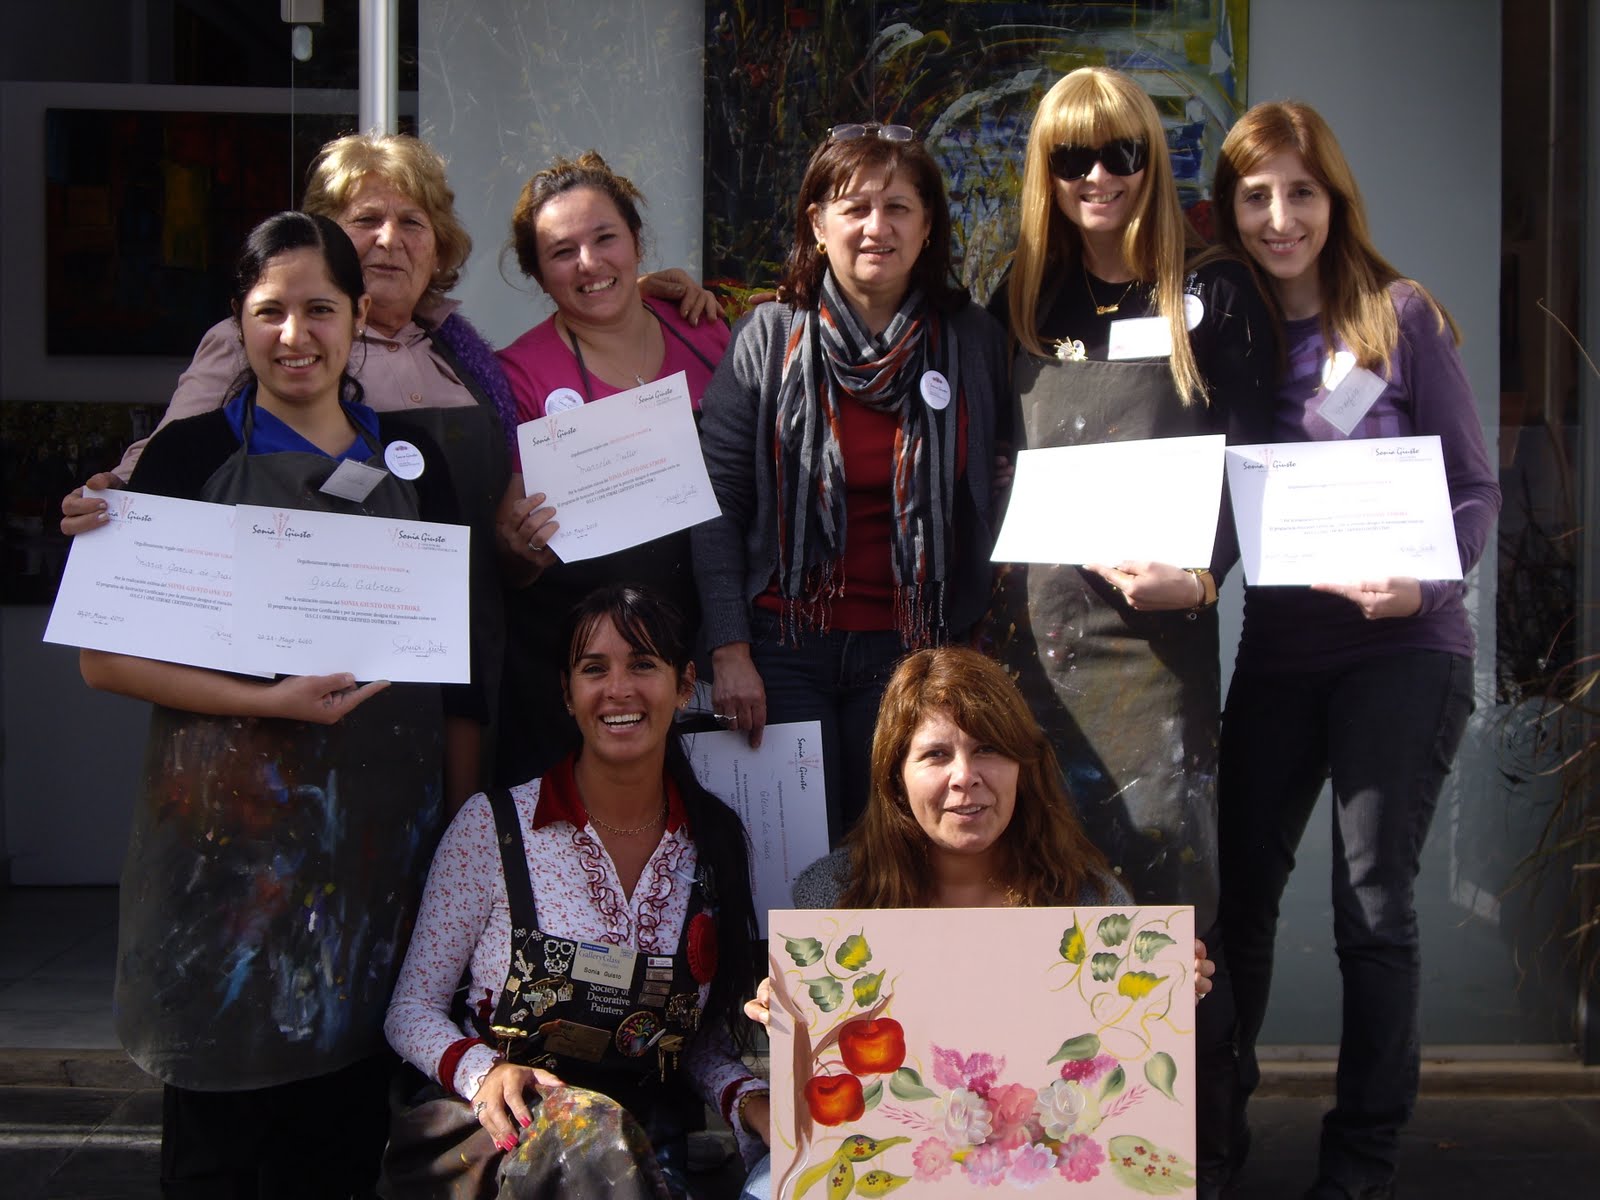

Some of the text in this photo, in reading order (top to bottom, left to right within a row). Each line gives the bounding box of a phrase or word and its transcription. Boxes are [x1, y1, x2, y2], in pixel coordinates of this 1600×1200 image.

[533, 427, 576, 446] Sonia Giusto
[1376, 447, 1420, 456] Sonia Giusto
[1243, 460, 1297, 470] Sonia Giusto
[127, 511, 152, 522] Giusto
[252, 524, 312, 538] Sonia Giusto
[398, 530, 446, 542] Sonia Giusto
[797, 738, 806, 758] Sonia
[800, 766, 808, 790] Giusto
[584, 967, 622, 980] Sonia Guisto
[590, 983, 619, 996] Society
[587, 991, 630, 1006] Decorative
[591, 1002, 624, 1016] Painters
